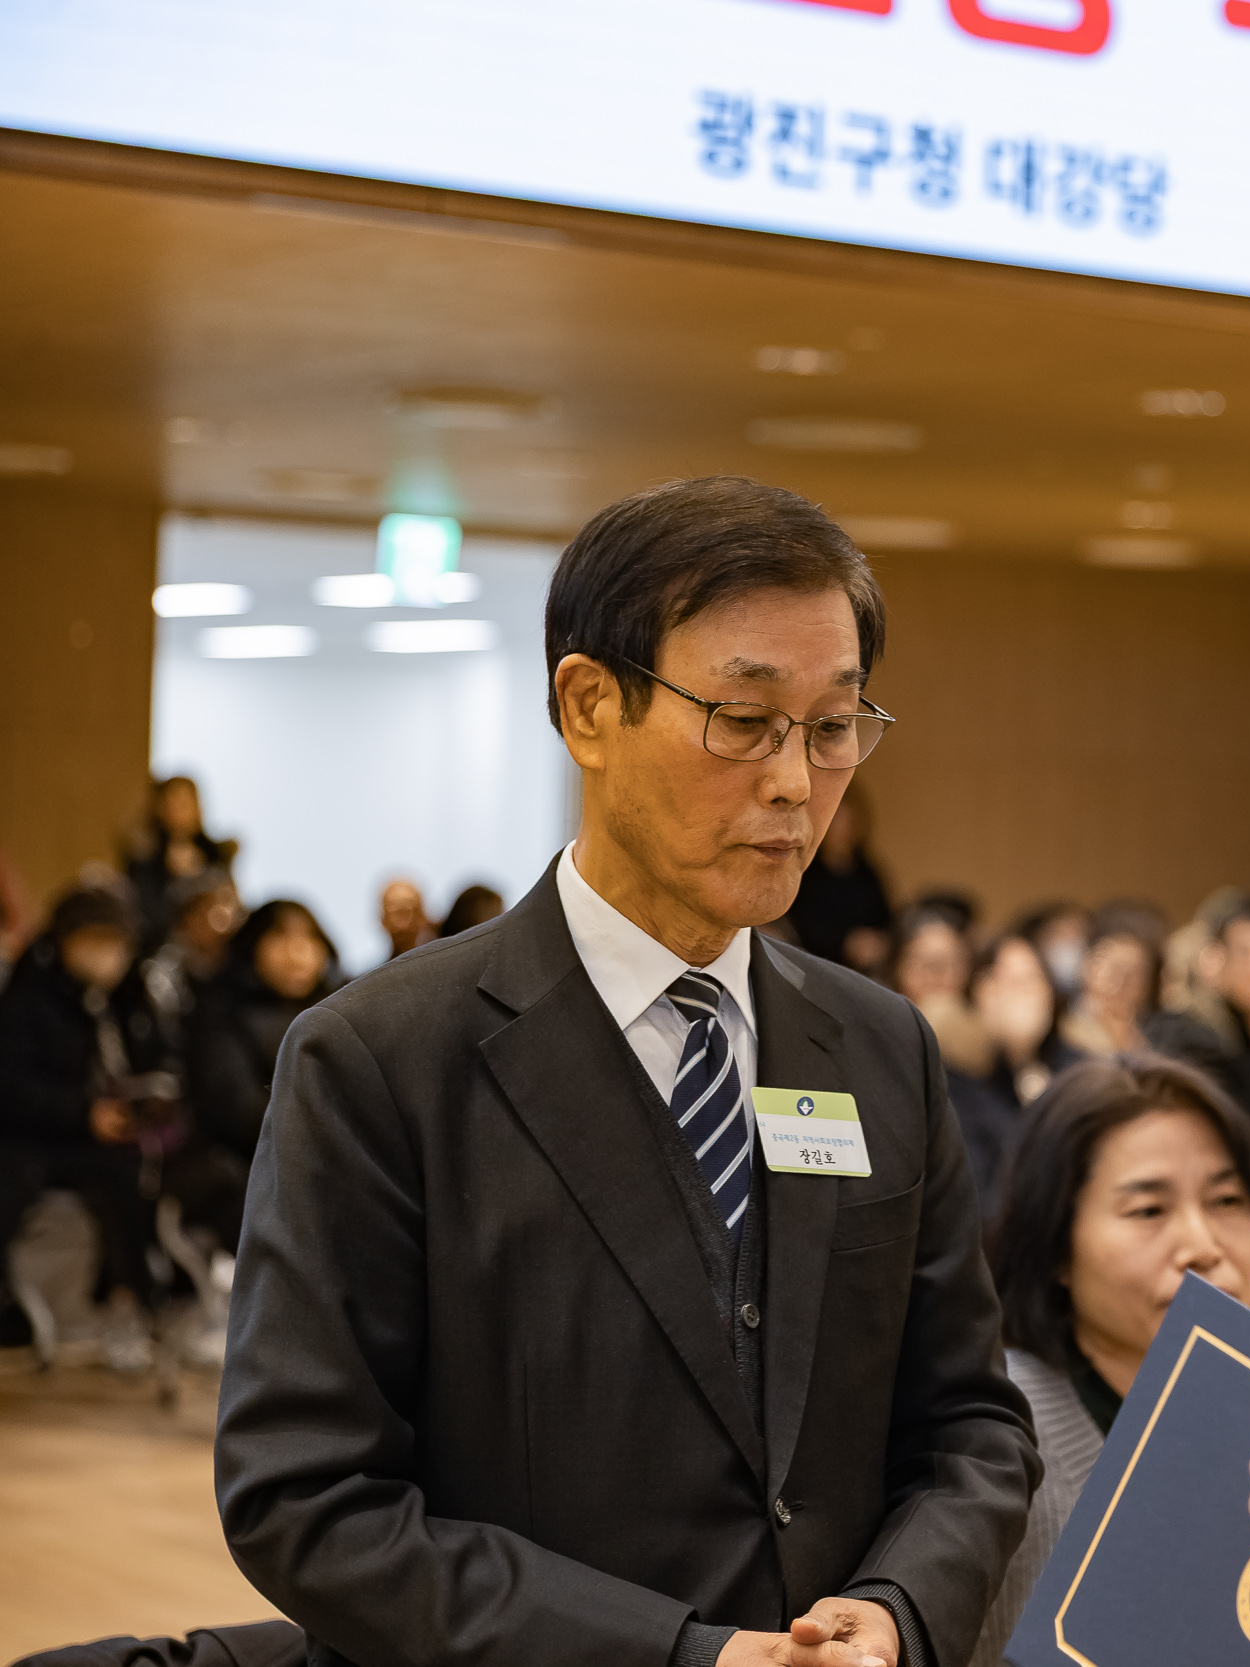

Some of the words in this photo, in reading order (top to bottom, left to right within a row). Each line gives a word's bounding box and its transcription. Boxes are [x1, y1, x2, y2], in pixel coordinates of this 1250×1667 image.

[694, 88, 964, 210] 광진구청
[983, 134, 1170, 239] 대강당
[799, 1148, 836, 1166] 장길호
